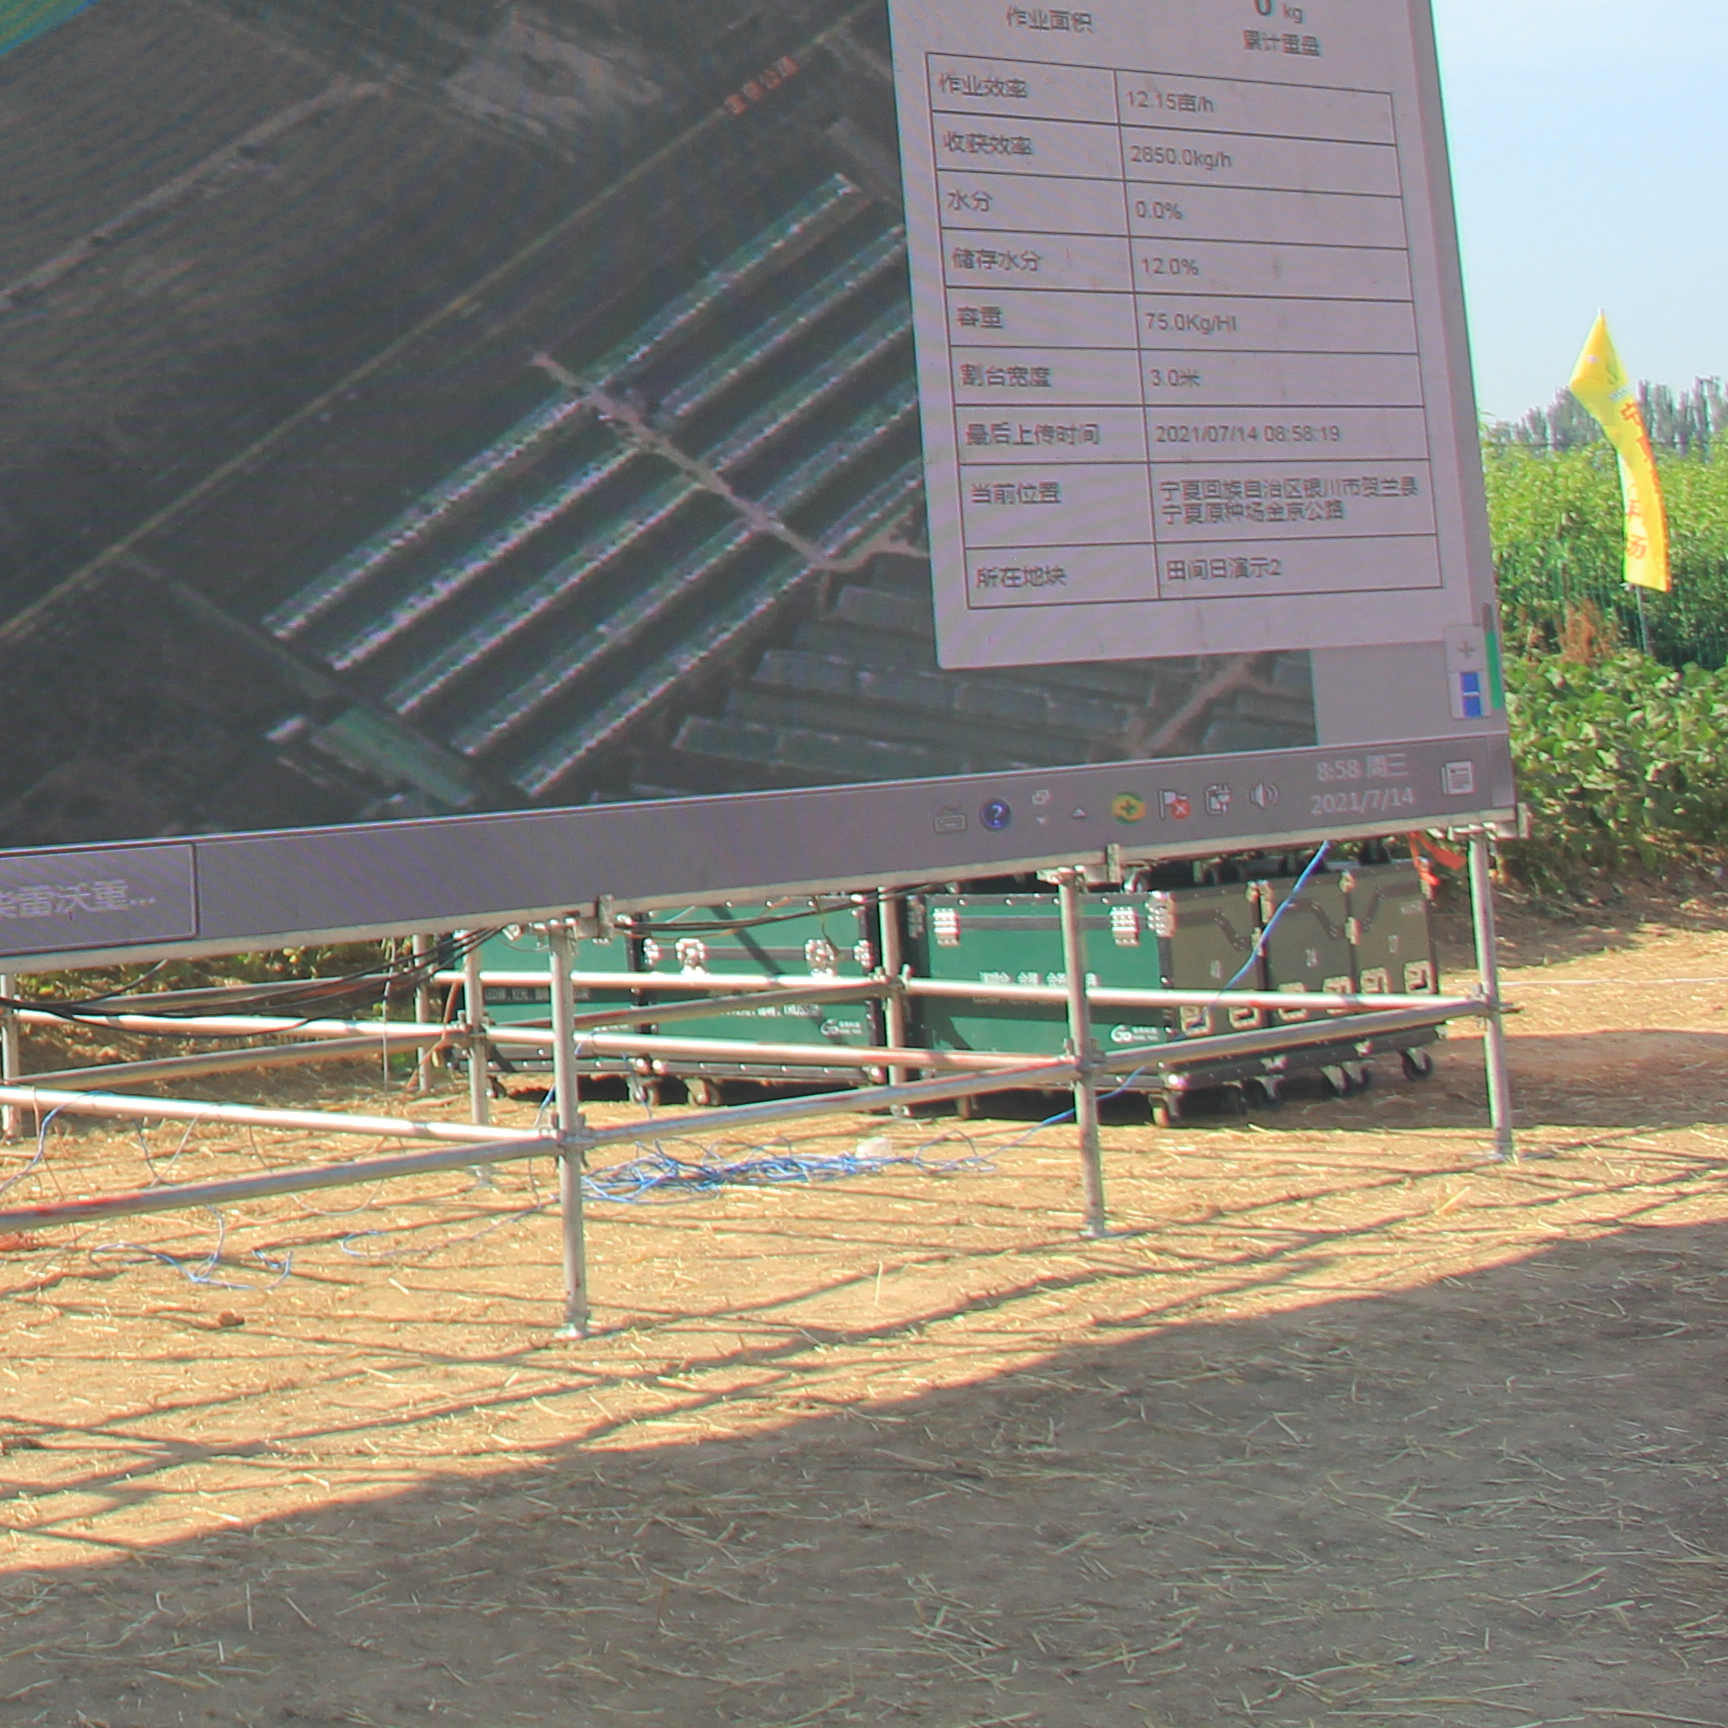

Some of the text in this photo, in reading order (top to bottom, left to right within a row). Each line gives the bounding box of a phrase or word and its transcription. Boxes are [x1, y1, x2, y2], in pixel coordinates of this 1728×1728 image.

[1005, 5, 1095, 34] 作业面积
[1282, 3, 1303, 24] kg
[938, 72, 1028, 98] 作业效率
[944, 130, 1033, 156] 收获效率
[948, 190, 1183, 221] 水分 0.0%
[952, 247, 1199, 276] 储存水分 12.0%
[965, 422, 1100, 446] 最后上传时间
[1155, 425, 1258, 443] 2021/07/14
[971, 480, 1062, 505] 当前位置
[1160, 475, 1419, 502] 宁夏回族自治区银川市贺兰县
[976, 565, 1068, 589] 所在地块
[1311, 787, 1414, 816] 2021/7/14
